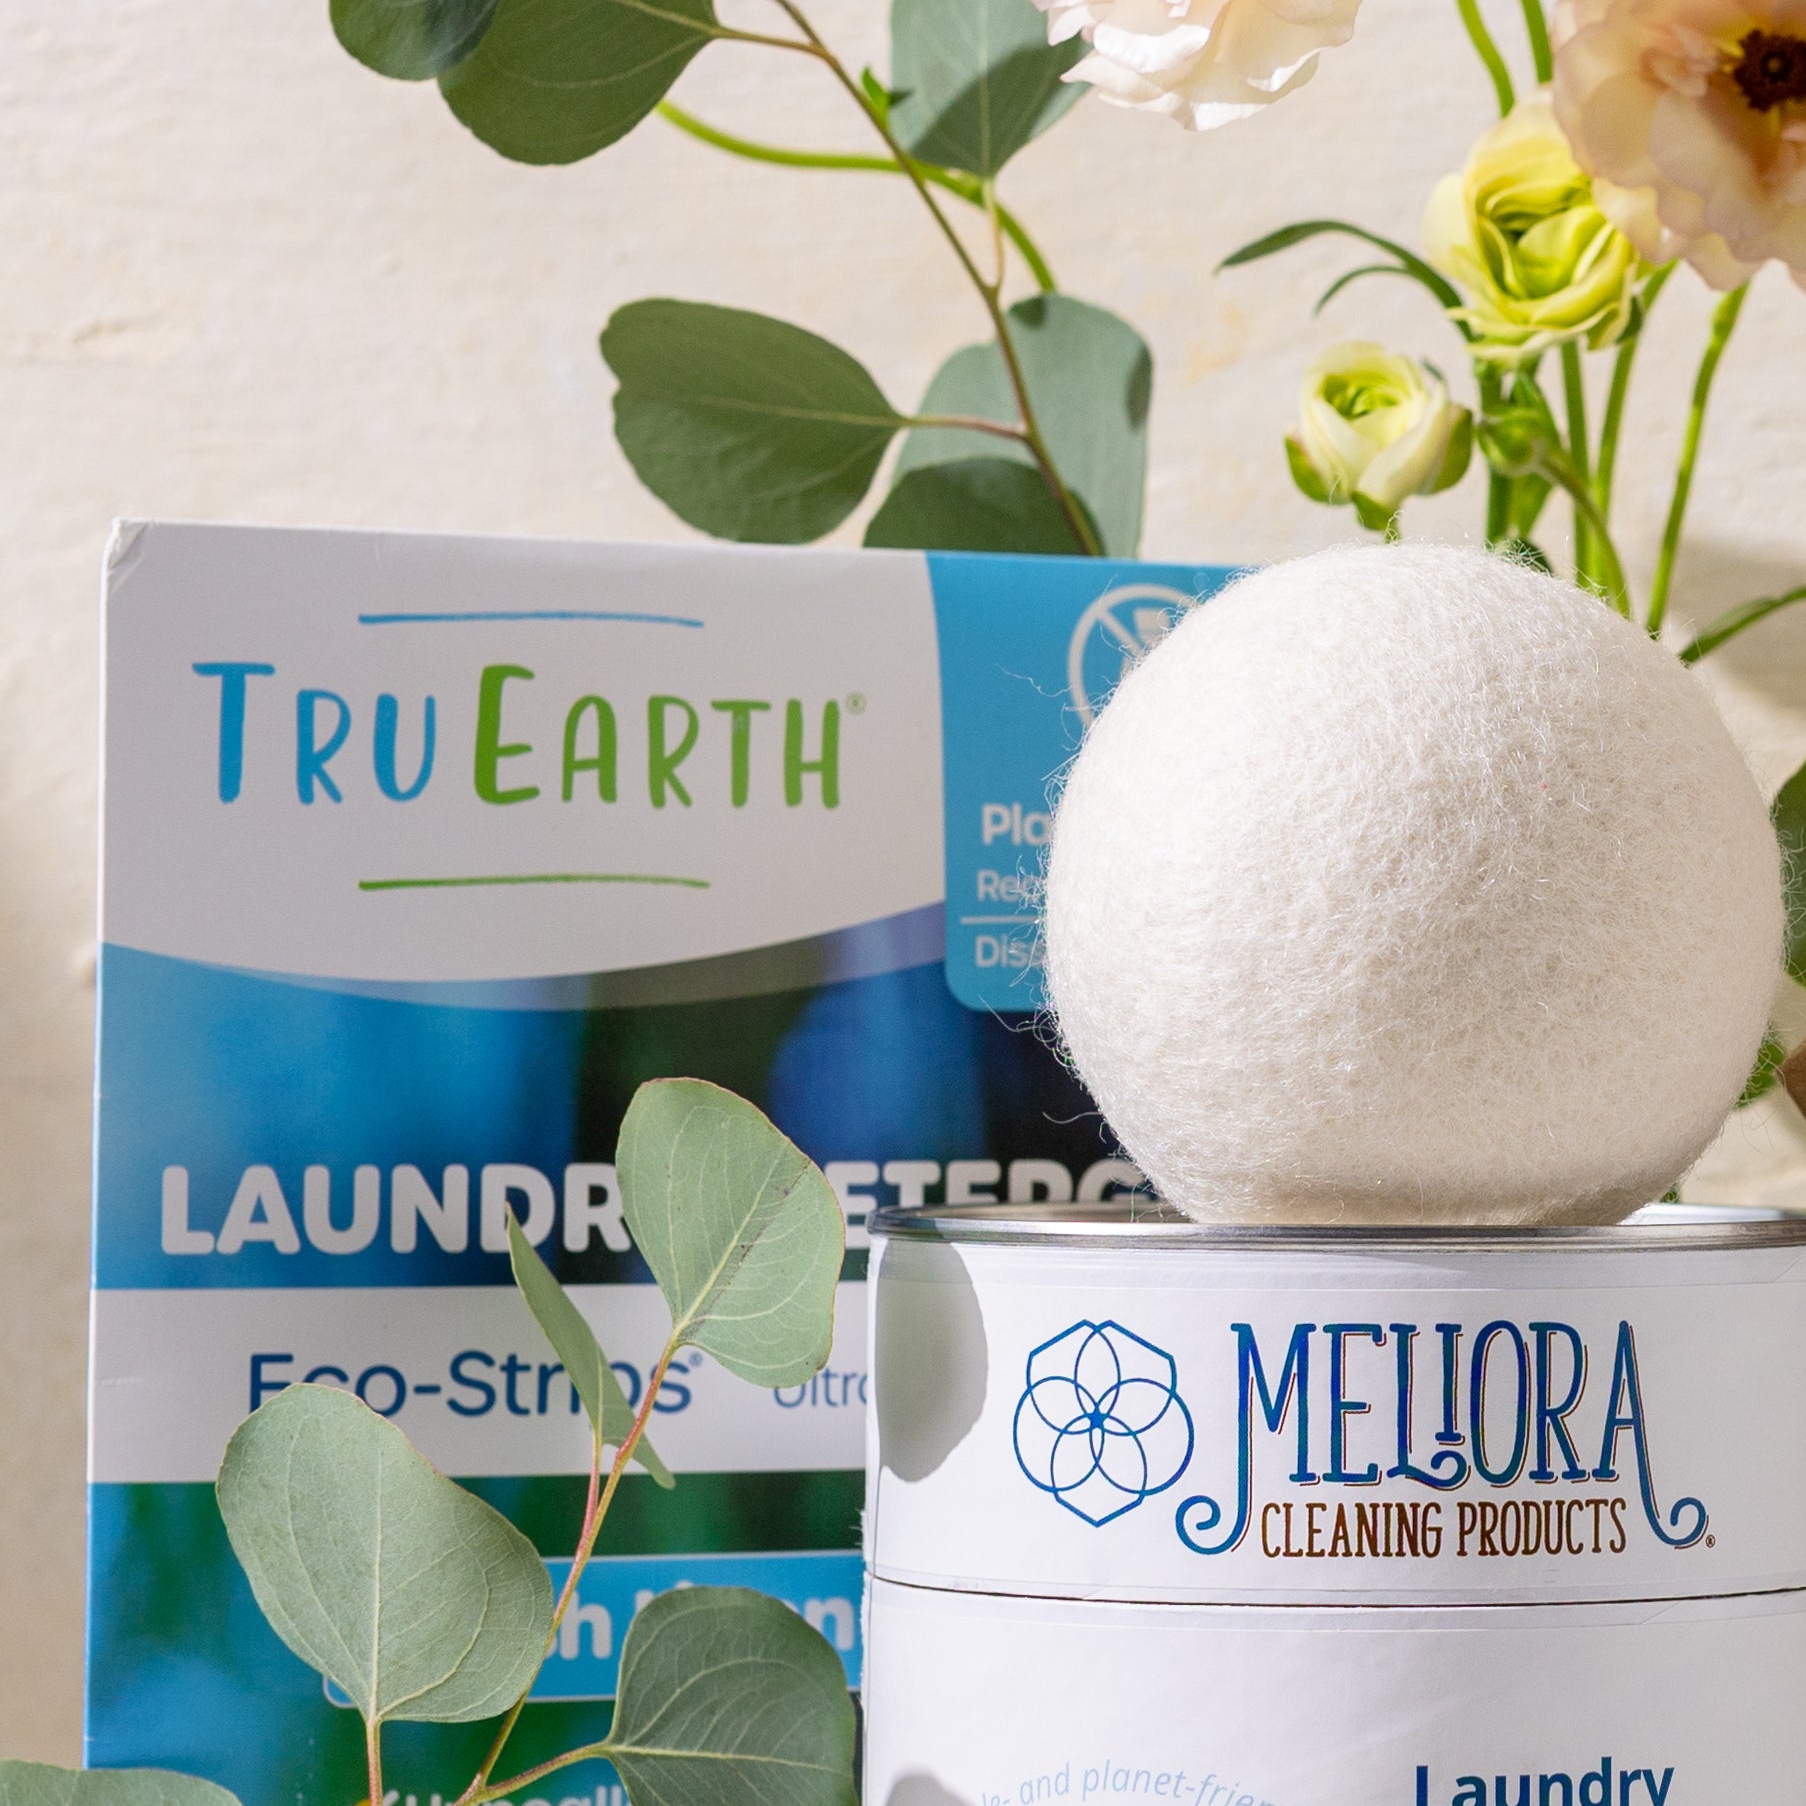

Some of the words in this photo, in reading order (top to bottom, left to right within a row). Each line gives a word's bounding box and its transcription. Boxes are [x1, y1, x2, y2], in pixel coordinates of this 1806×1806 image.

[161, 1163, 632, 1254] LAUNDR
[1261, 1501, 1443, 1559] CLEANING
[1456, 1497, 1627, 1557] PRODUCTS
[1019, 1761, 1070, 1806] and
